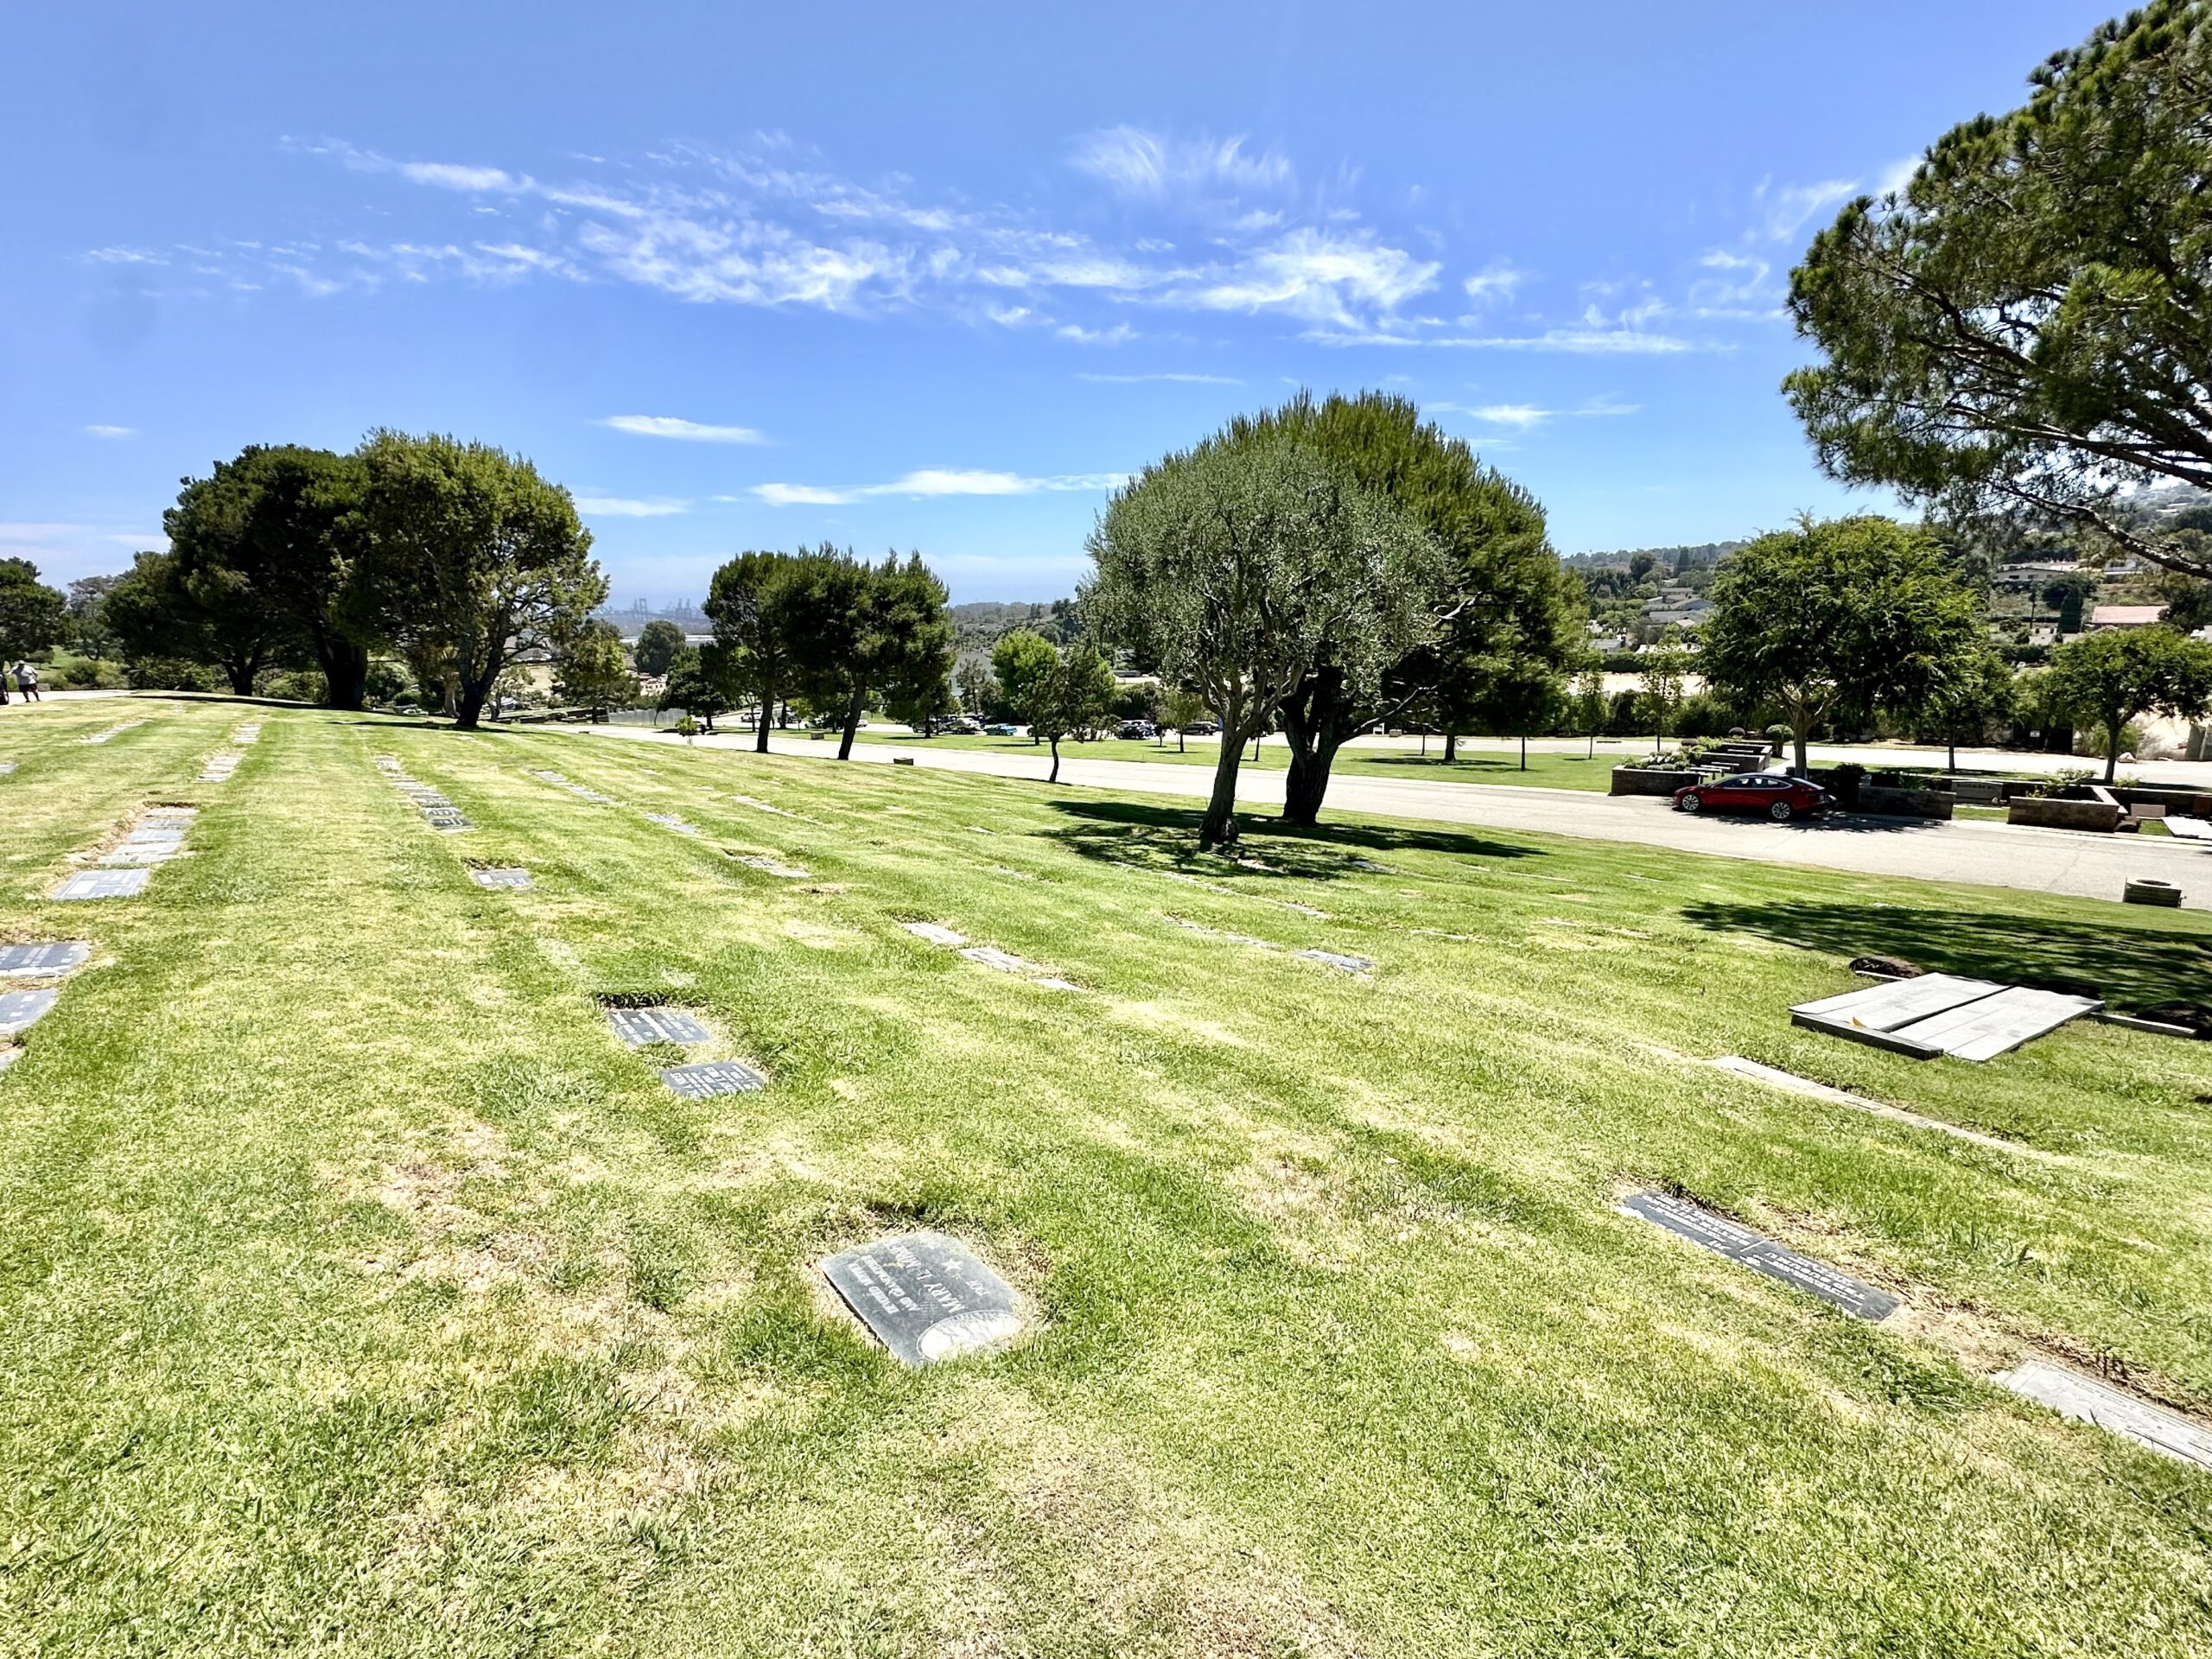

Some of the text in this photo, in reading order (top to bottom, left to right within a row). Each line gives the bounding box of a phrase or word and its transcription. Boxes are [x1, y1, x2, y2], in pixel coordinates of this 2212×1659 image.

[866, 1284, 900, 1314] DEVOTED
[899, 1295, 921, 1313] AND
[921, 1281, 965, 1313] MARY
